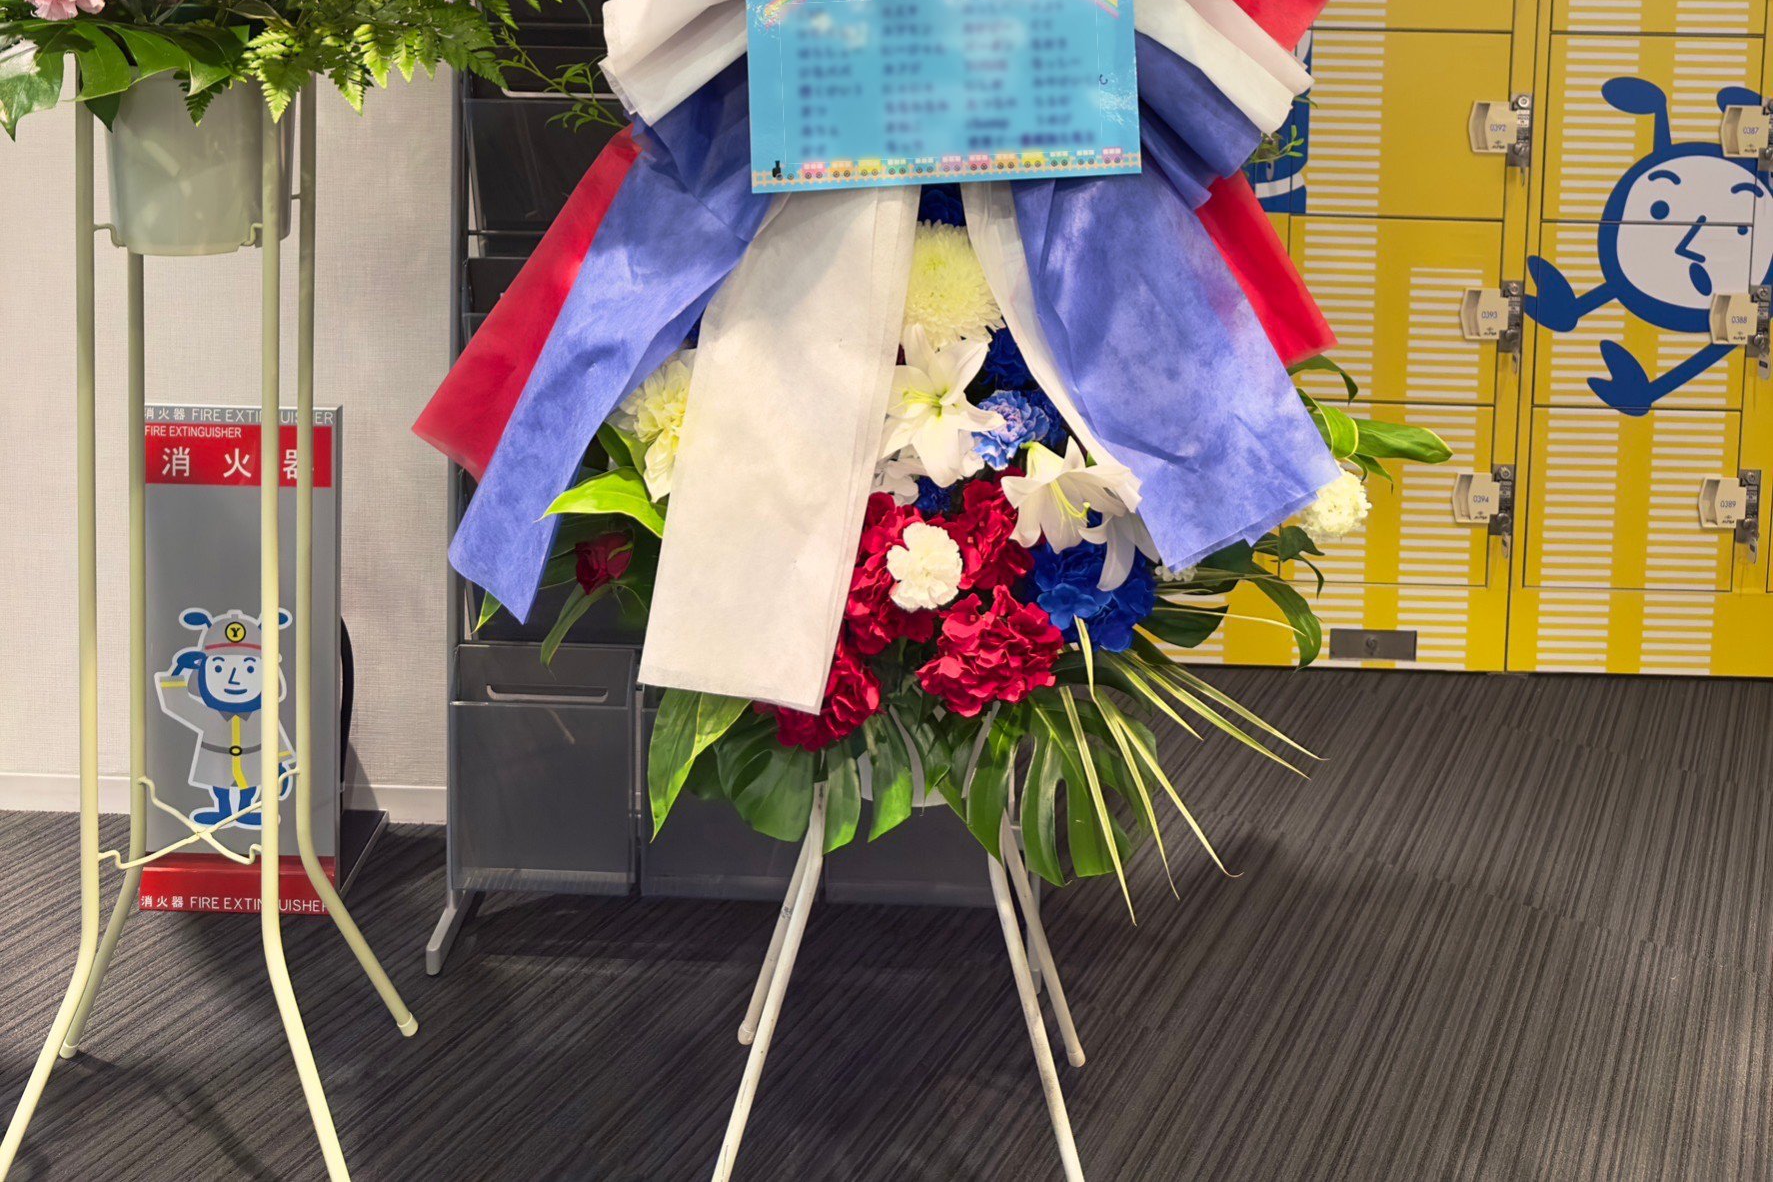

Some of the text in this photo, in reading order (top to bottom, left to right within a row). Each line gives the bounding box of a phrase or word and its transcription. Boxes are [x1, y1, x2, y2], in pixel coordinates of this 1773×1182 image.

[192, 408, 222, 422] FIRE
[144, 425, 242, 438] FIRE EXTINGUISHER
[141, 895, 184, 908] 消火器
[190, 896, 219, 910] FIRE
